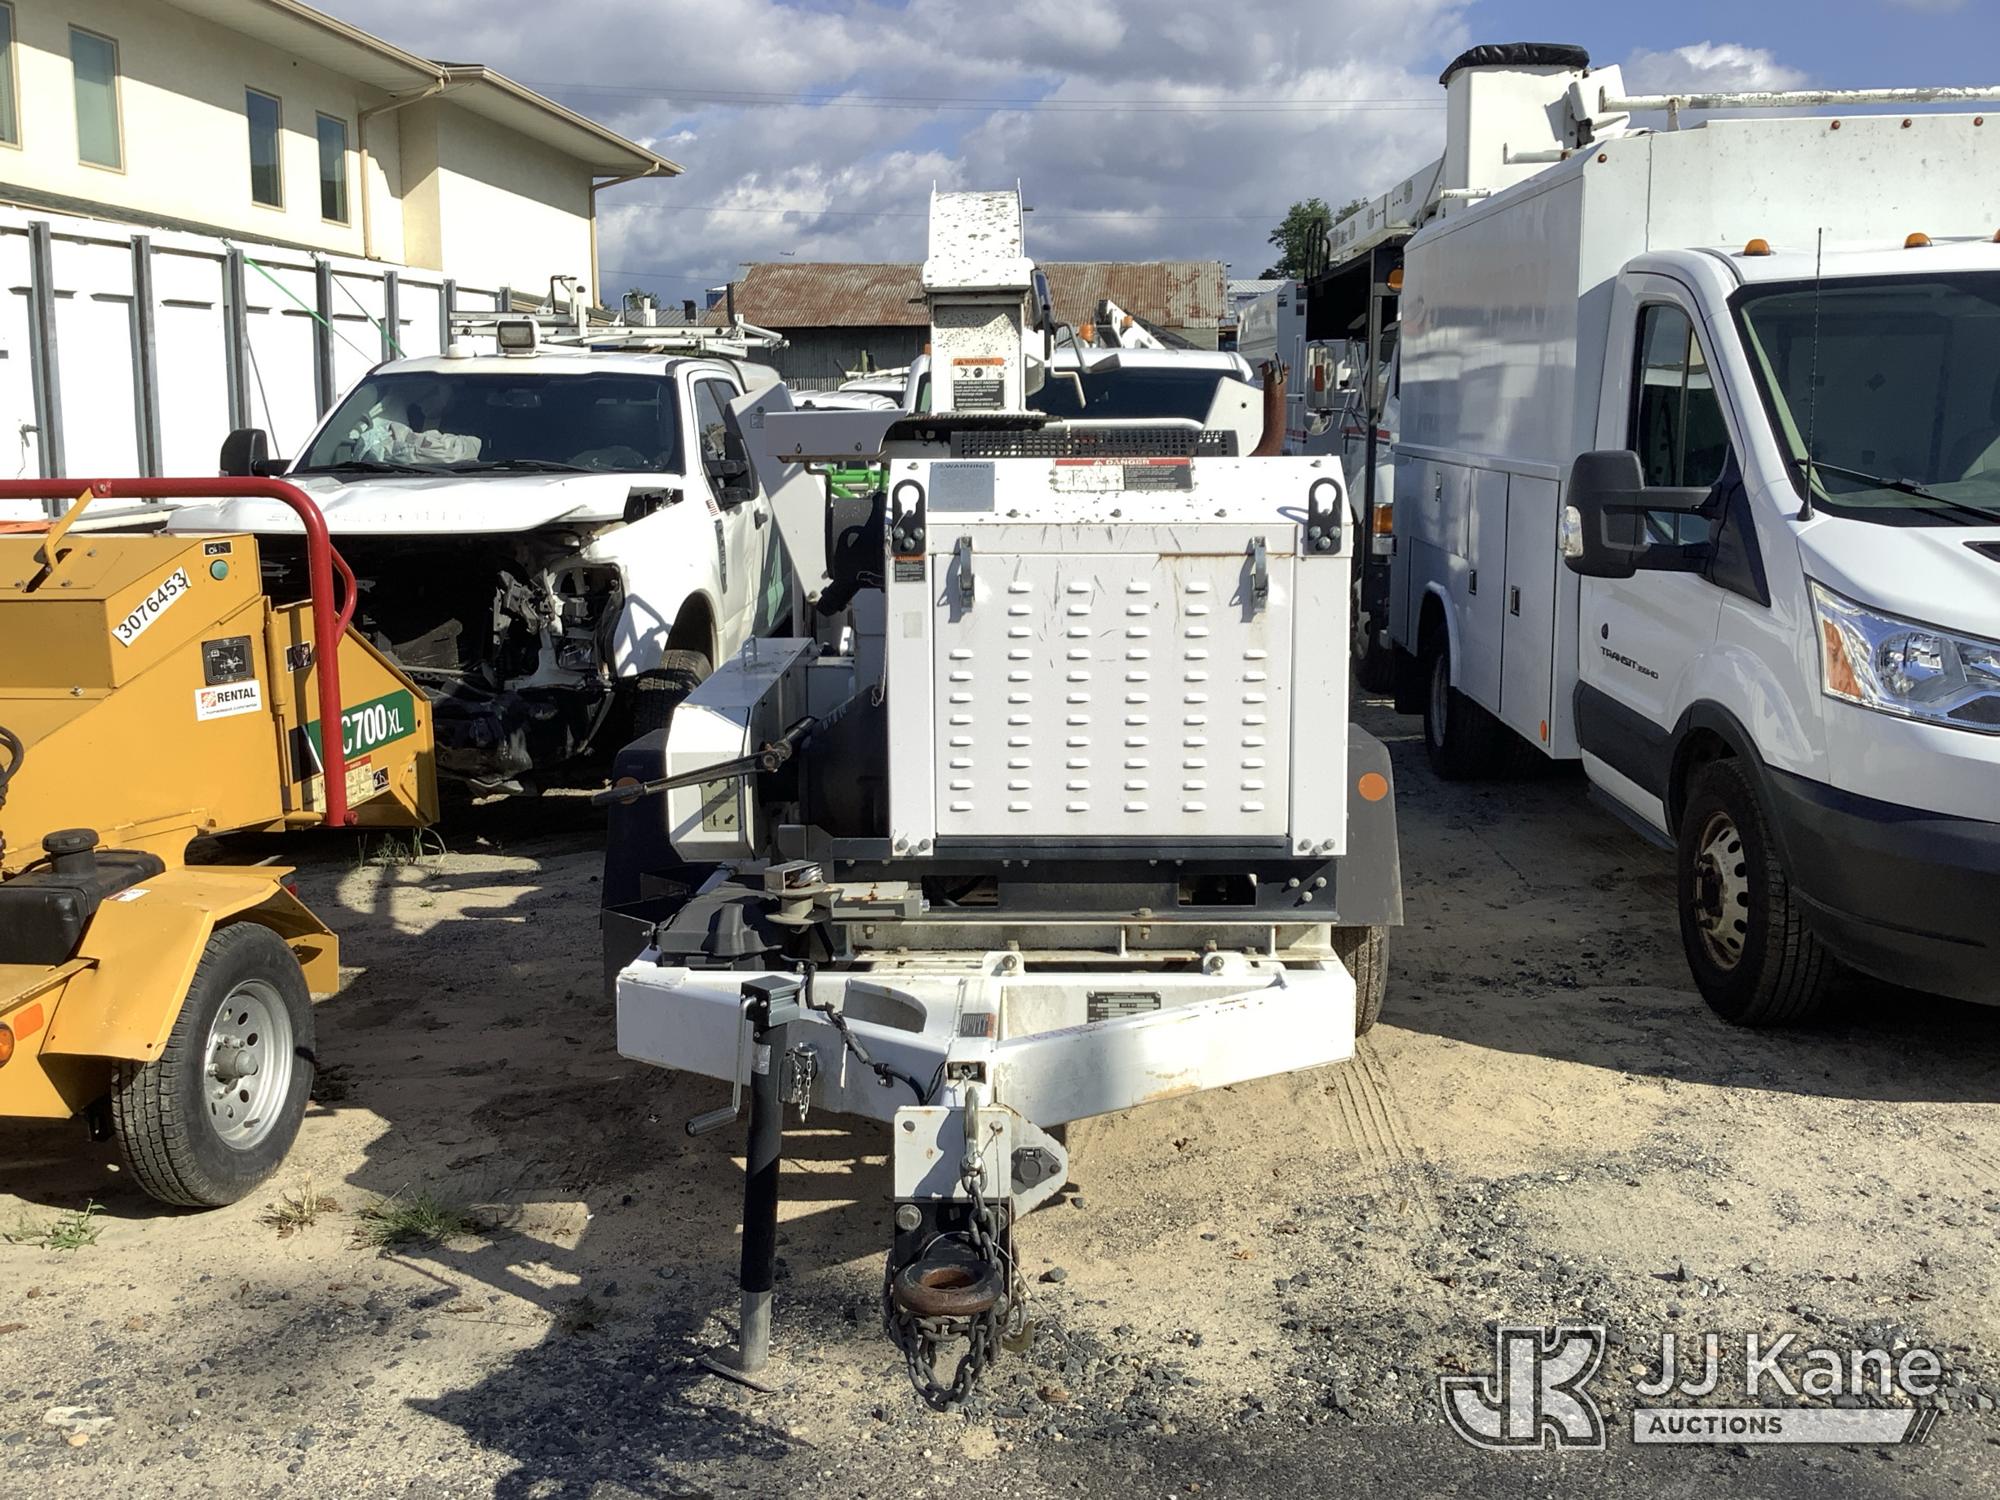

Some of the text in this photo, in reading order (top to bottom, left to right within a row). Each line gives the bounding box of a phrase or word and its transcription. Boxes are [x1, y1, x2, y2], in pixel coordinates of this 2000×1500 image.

[118, 572, 187, 639] 3076453
[1600, 646, 1638, 669] TRANSIT
[217, 687, 256, 704] RENTAL
